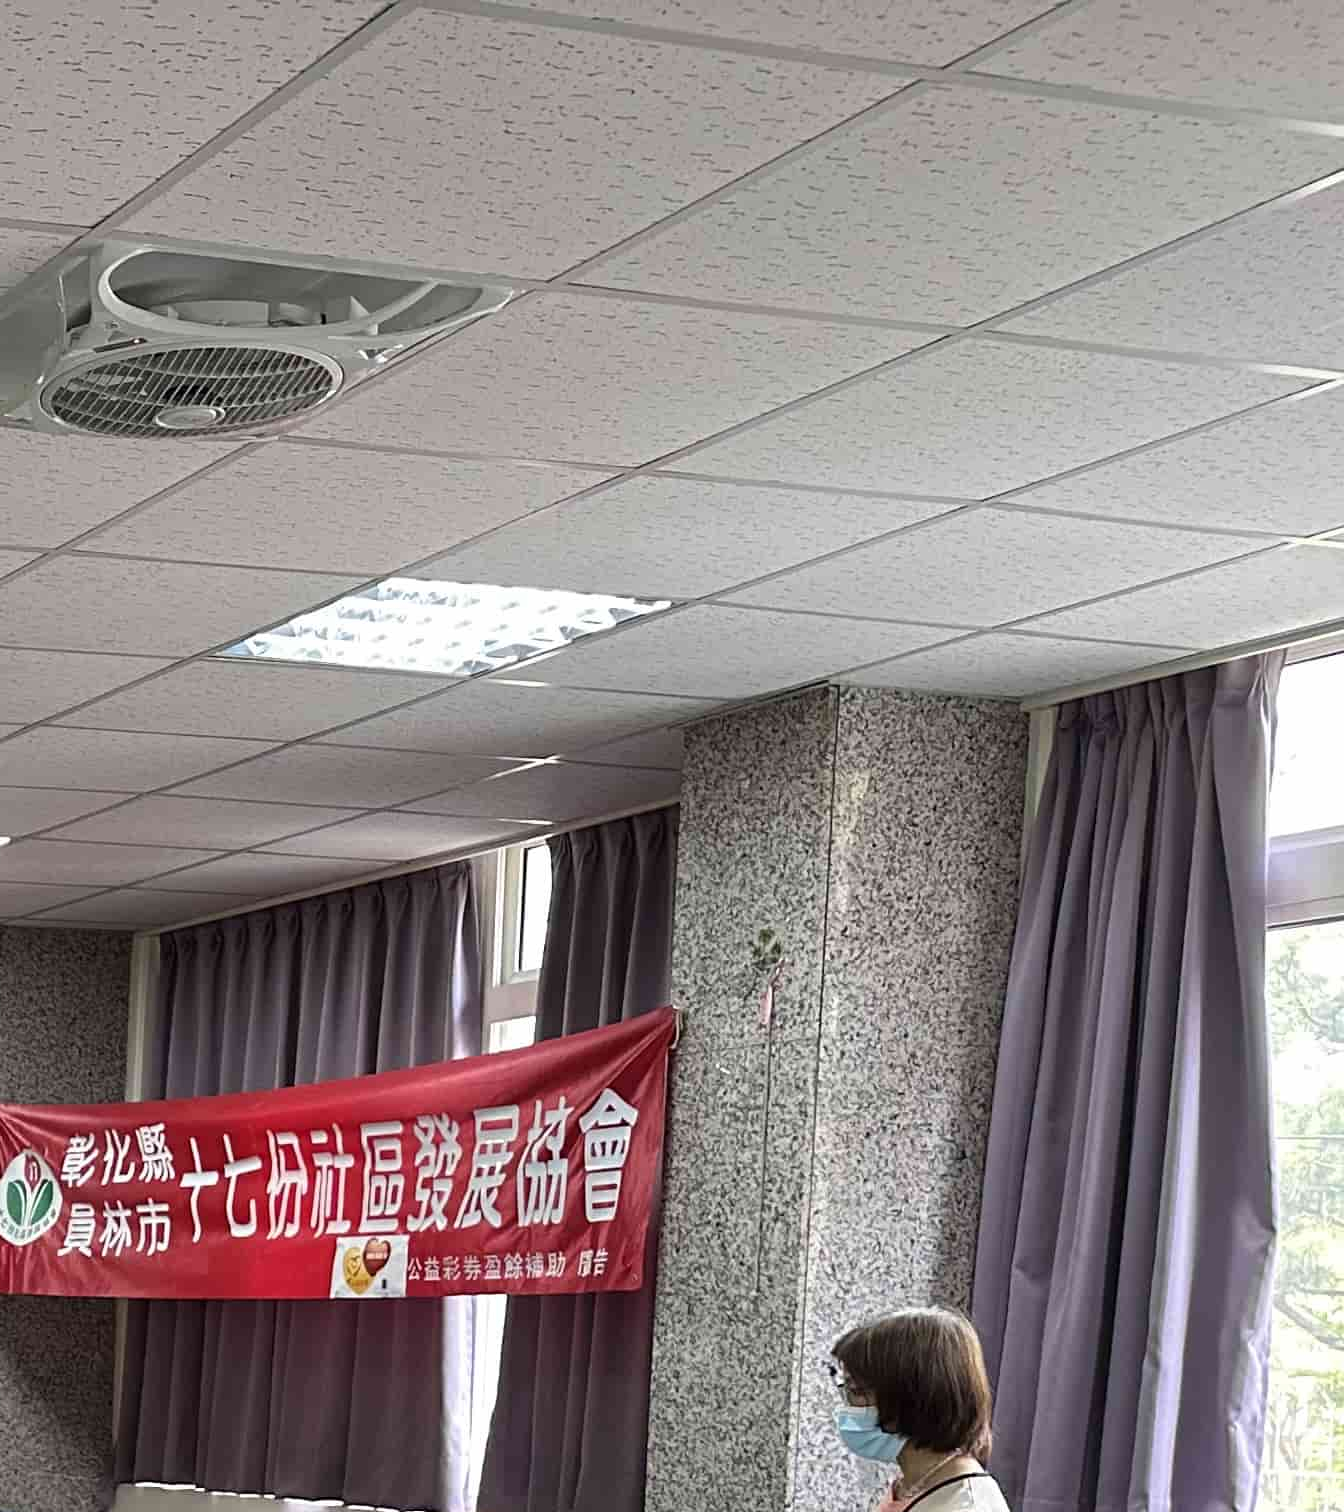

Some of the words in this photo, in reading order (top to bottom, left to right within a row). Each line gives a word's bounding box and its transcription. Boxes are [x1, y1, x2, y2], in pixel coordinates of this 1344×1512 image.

[60, 1122, 176, 1188] 彰化縣
[179, 1087, 640, 1243] 十七份社區發展協會
[56, 1197, 172, 1257] 員林市
[407, 1251, 567, 1281] 公益彩券盈餘補助
[576, 1247, 610, 1278] 廣告
